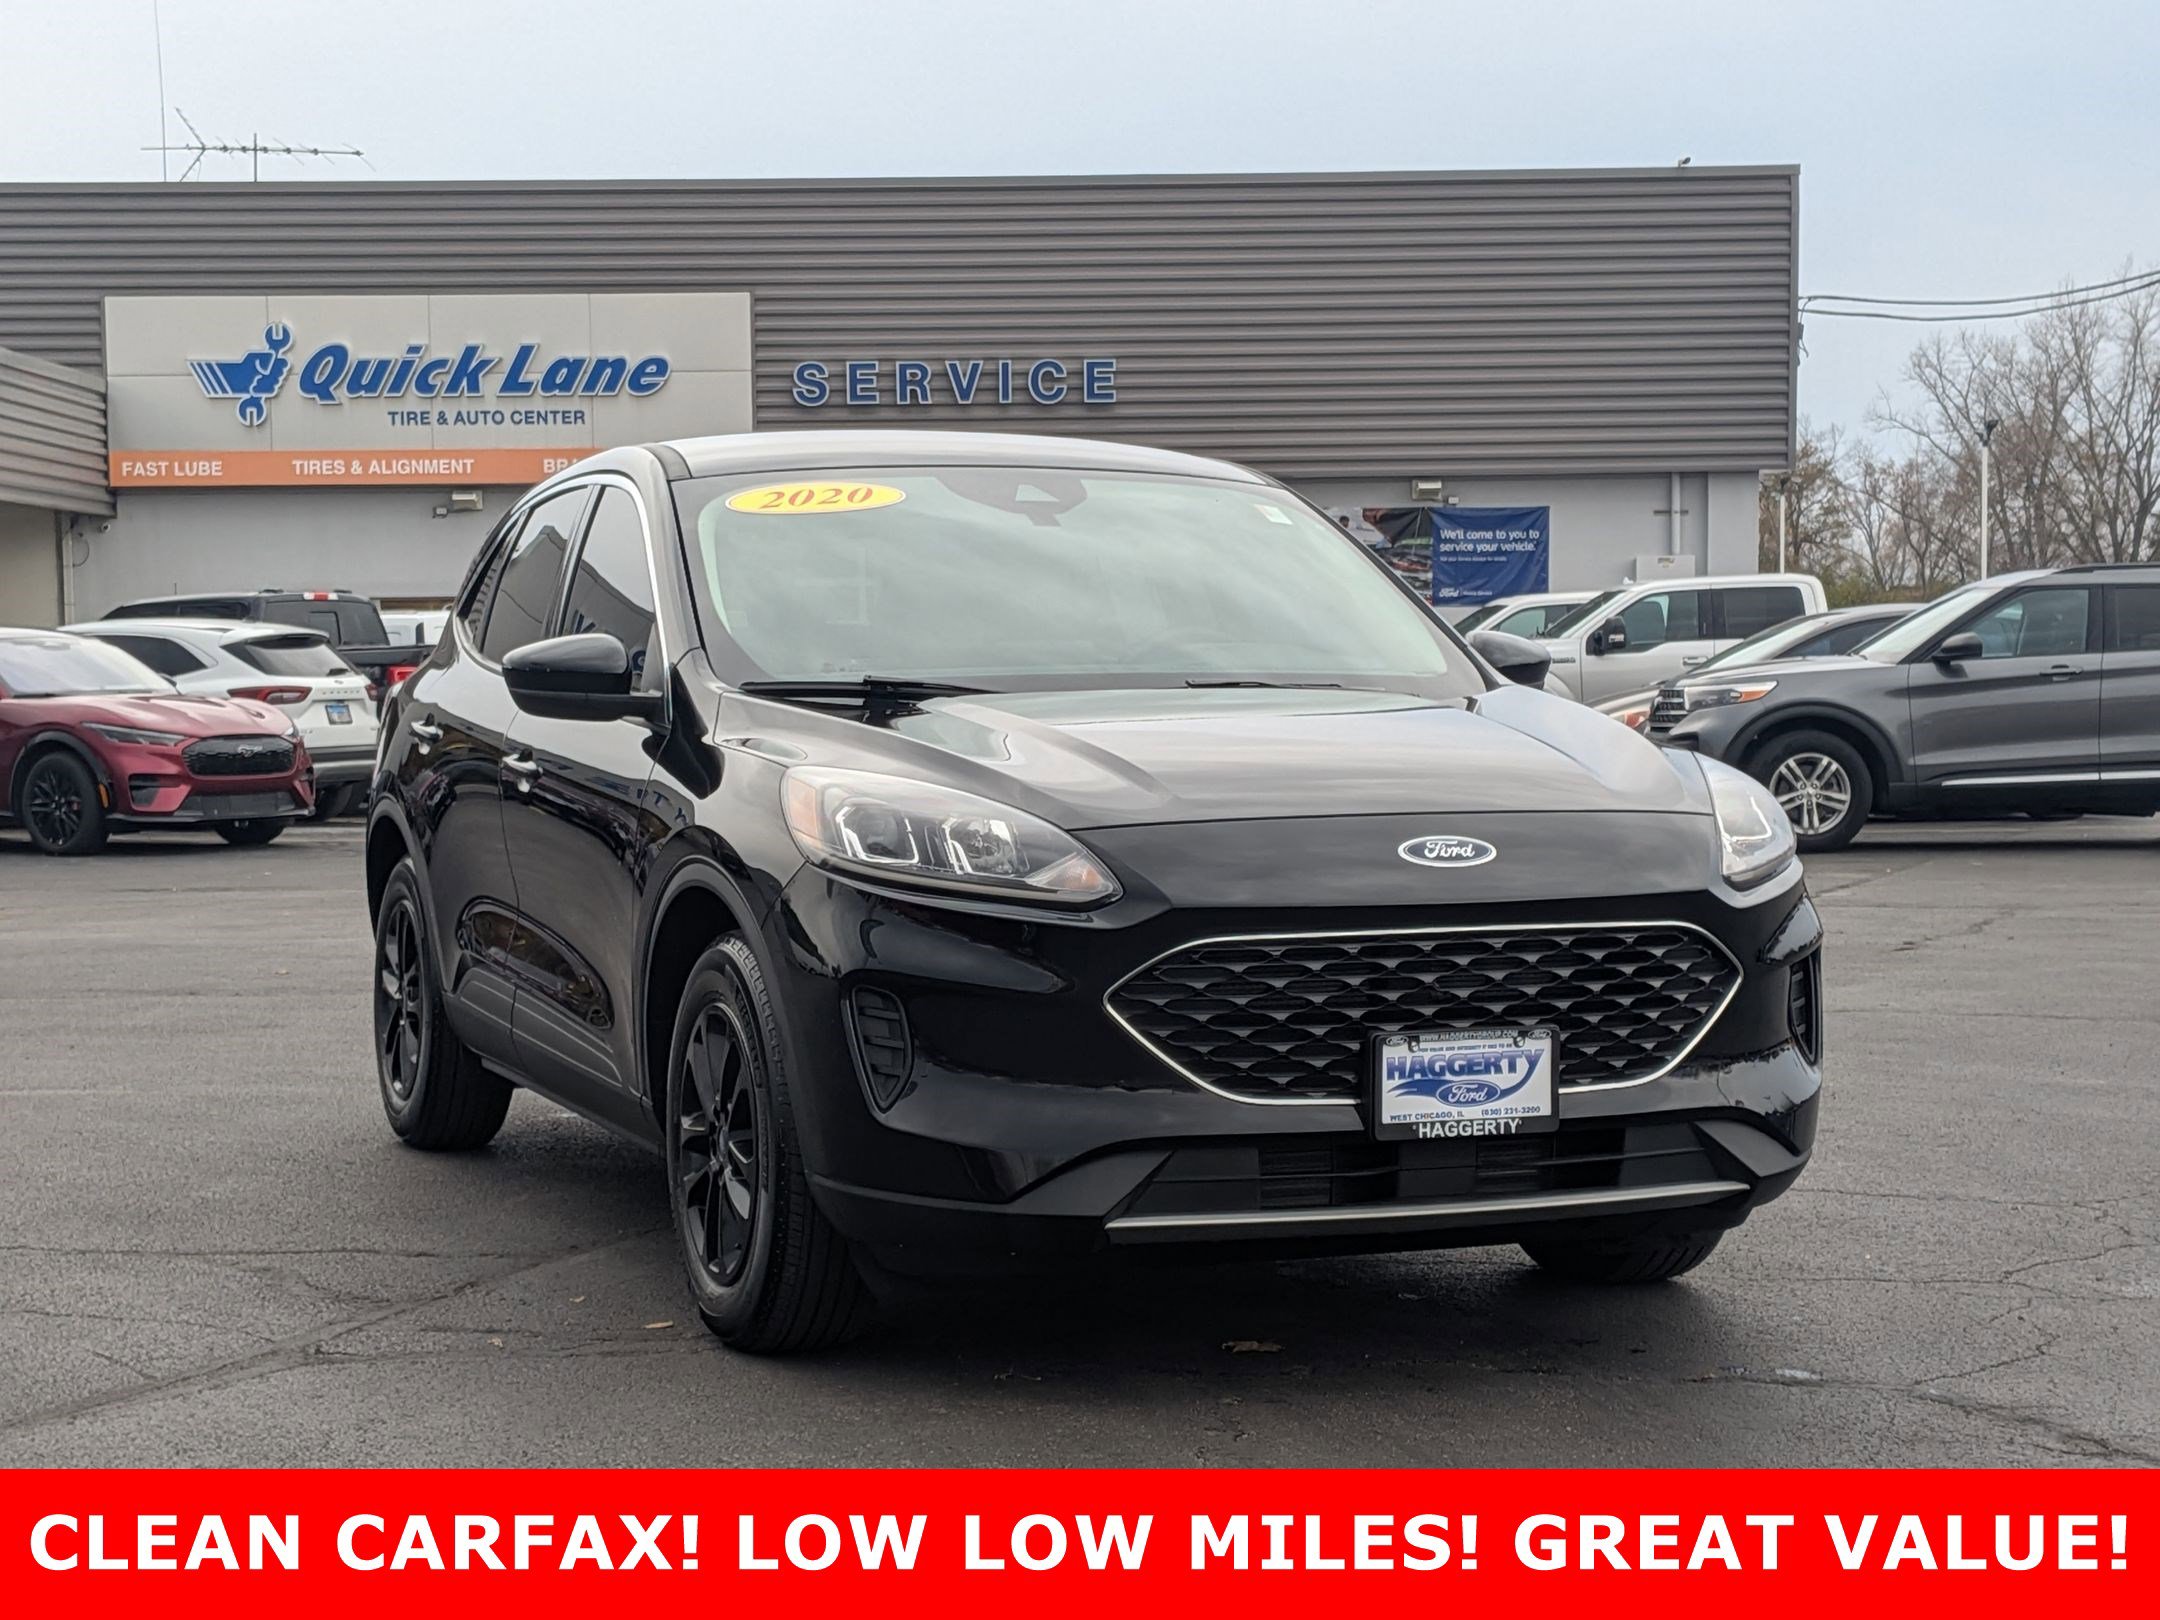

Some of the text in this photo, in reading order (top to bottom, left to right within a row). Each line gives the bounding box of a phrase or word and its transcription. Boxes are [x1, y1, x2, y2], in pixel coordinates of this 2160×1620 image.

[299, 342, 671, 405] Quick Lane
[792, 358, 1117, 407] SERVICE
[388, 410, 585, 426] TIRE & AUTO CENTER
[121, 460, 223, 477] FAST LUBE
[292, 458, 475, 475] TIRES & ALIGNMENT
[543, 458, 577, 474] BR
[759, 487, 873, 509] 2020
[1440, 528, 1540, 542] We'll come to you to
[1440, 542, 1474, 552] service
[1476, 543, 1498, 554] your
[1424, 840, 1475, 859] Ford
[1386, 1048, 1545, 1080] HAGGERTY
[1448, 1084, 1488, 1103] Ford
[1390, 1114, 1413, 1122] WEST
[1457, 1110, 1465, 1118] IL
[1418, 1118, 1520, 1139] HAGGERTY
